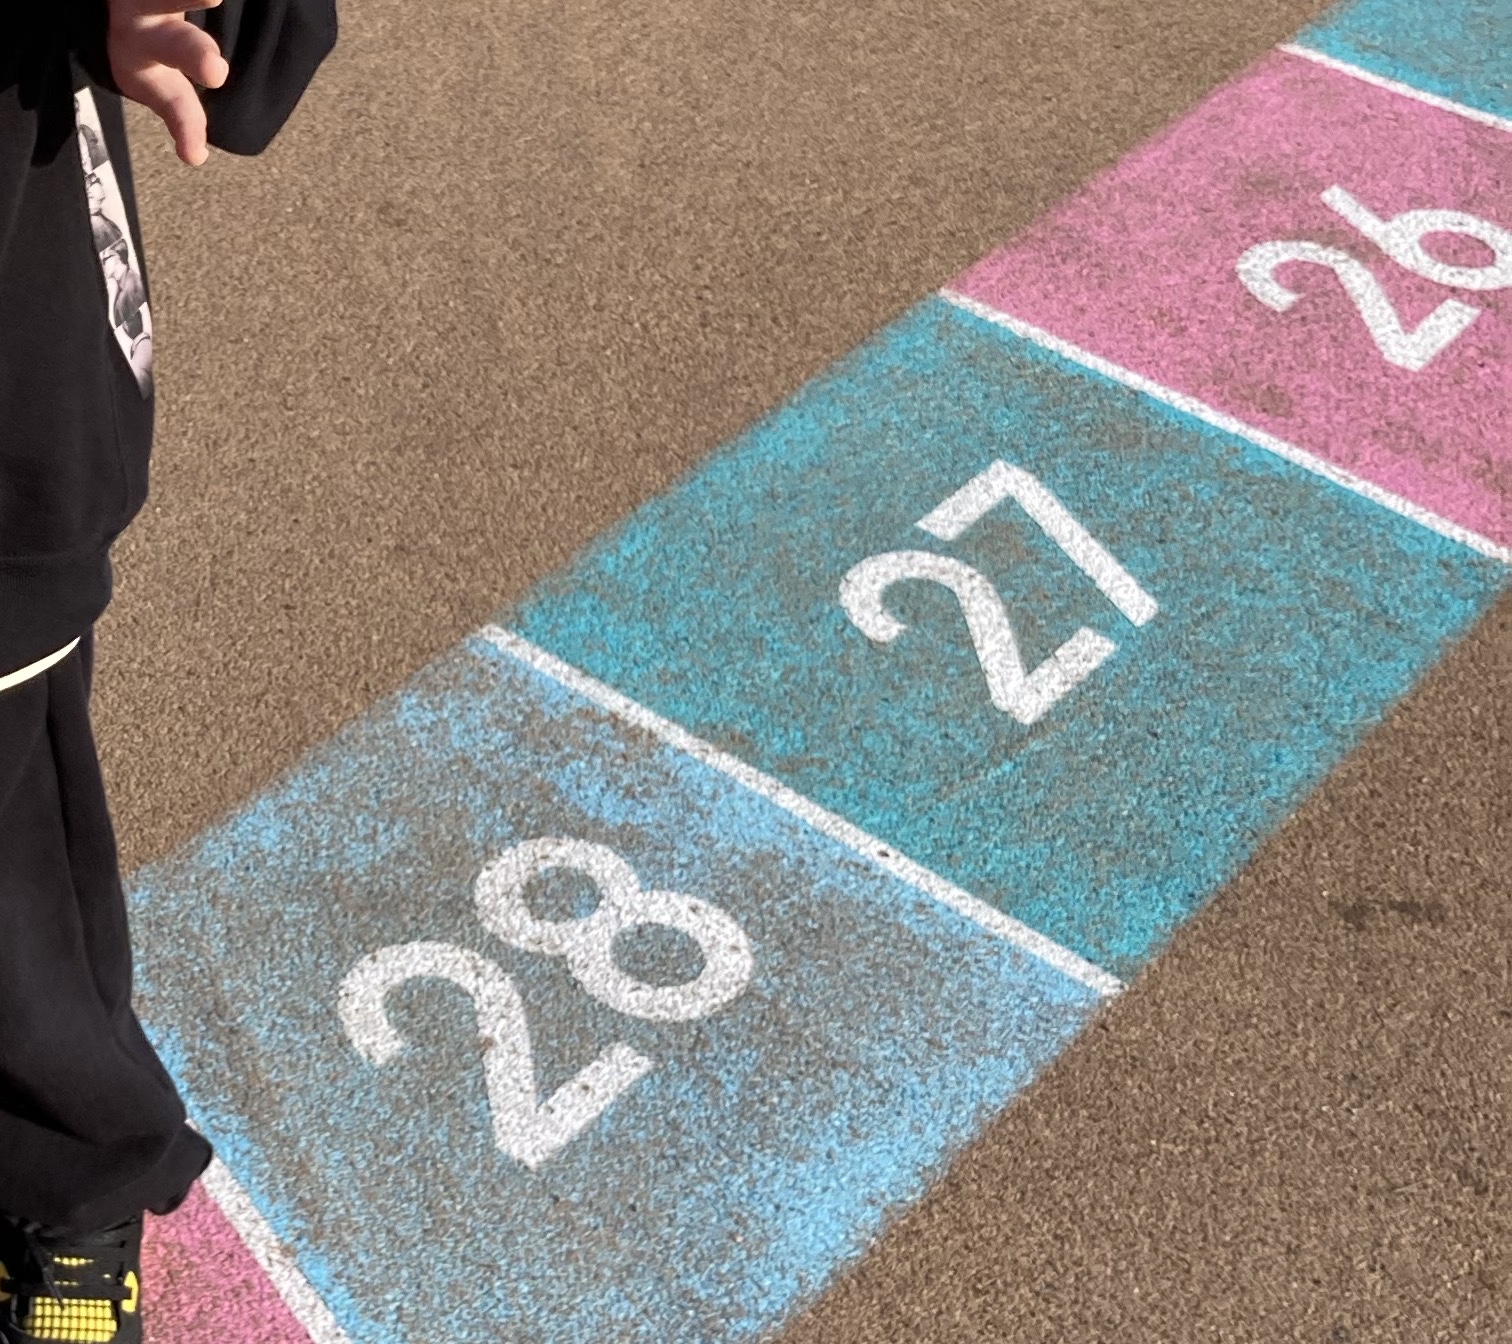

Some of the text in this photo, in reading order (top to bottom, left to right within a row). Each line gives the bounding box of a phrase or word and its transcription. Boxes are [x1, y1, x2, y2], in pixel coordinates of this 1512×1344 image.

[1235, 184, 1512, 372] 26
[839, 459, 1159, 725] 27
[338, 836, 754, 1170] 28
